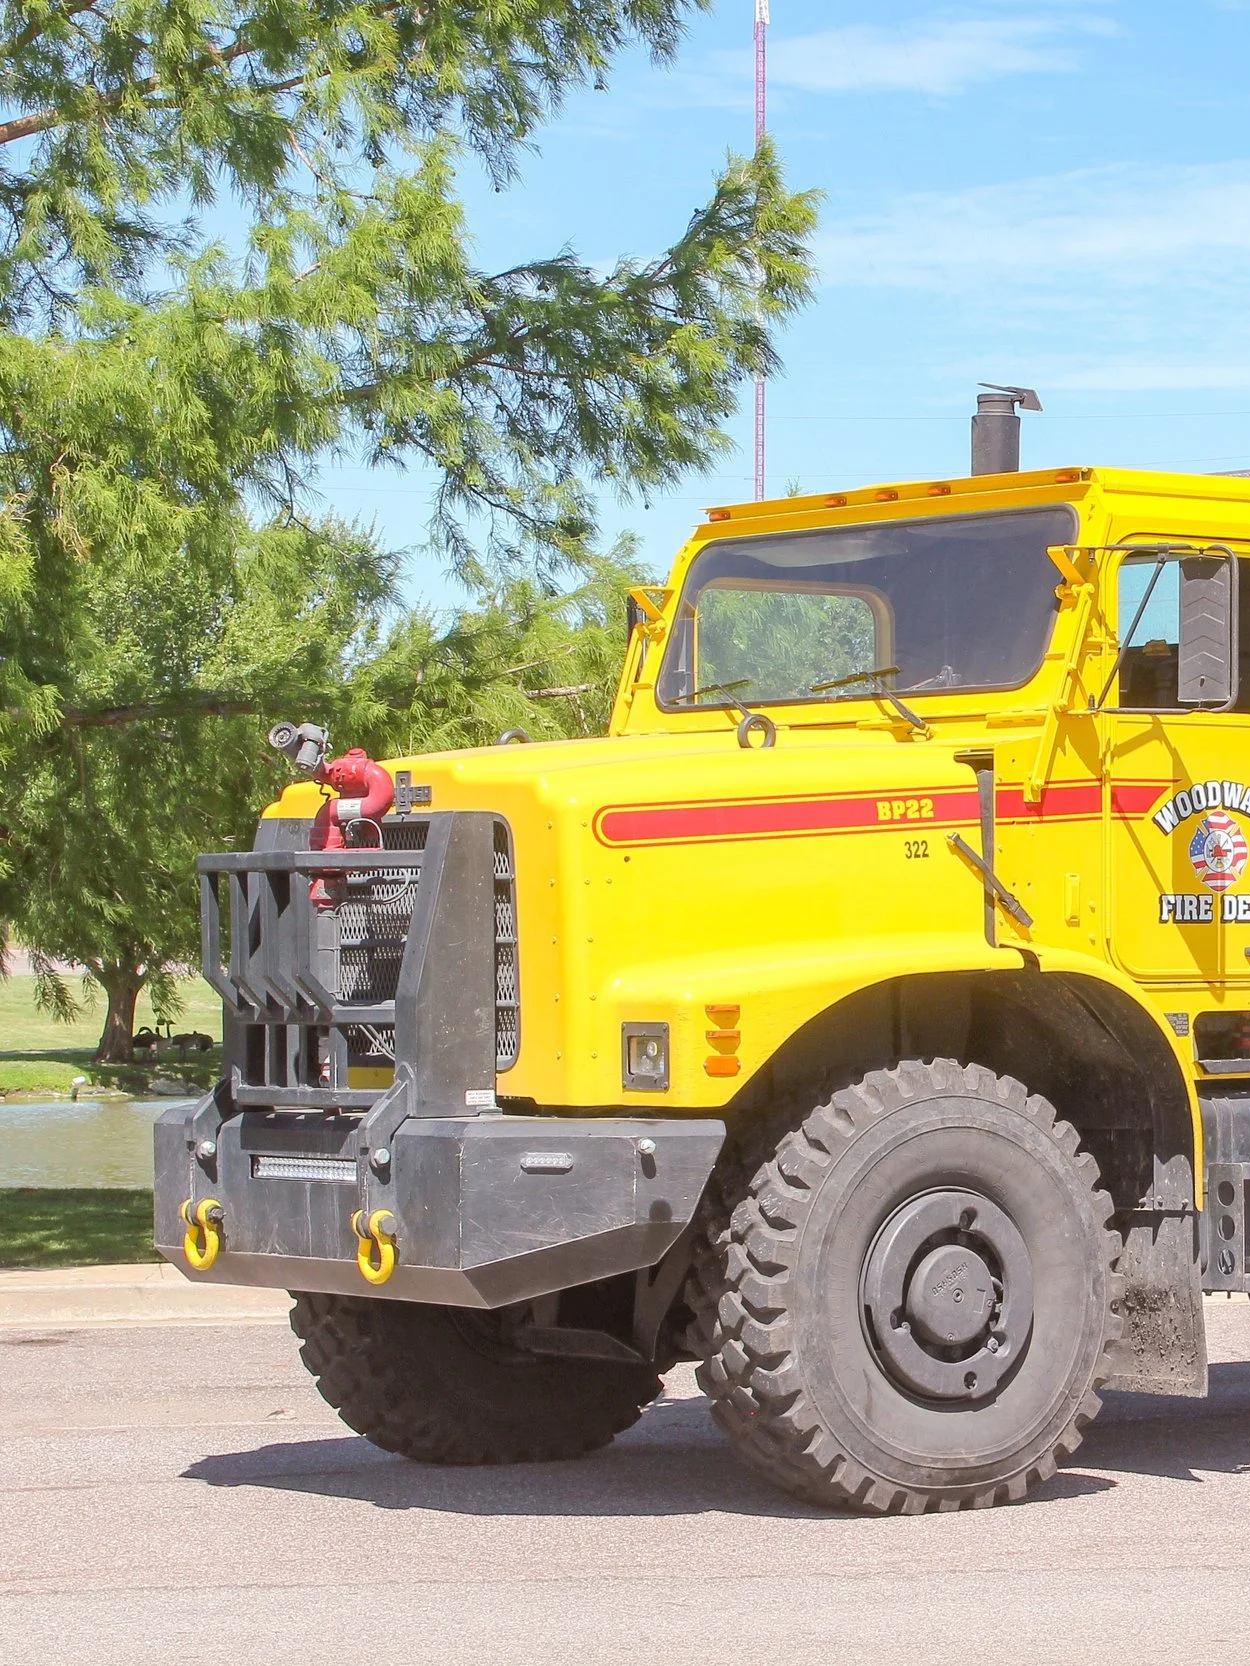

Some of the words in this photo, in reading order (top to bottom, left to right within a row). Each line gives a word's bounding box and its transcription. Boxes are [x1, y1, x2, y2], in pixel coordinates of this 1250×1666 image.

[876, 798, 934, 821] BP22
[904, 840, 929, 859] 322
[1159, 893, 1213, 924] FIRE
